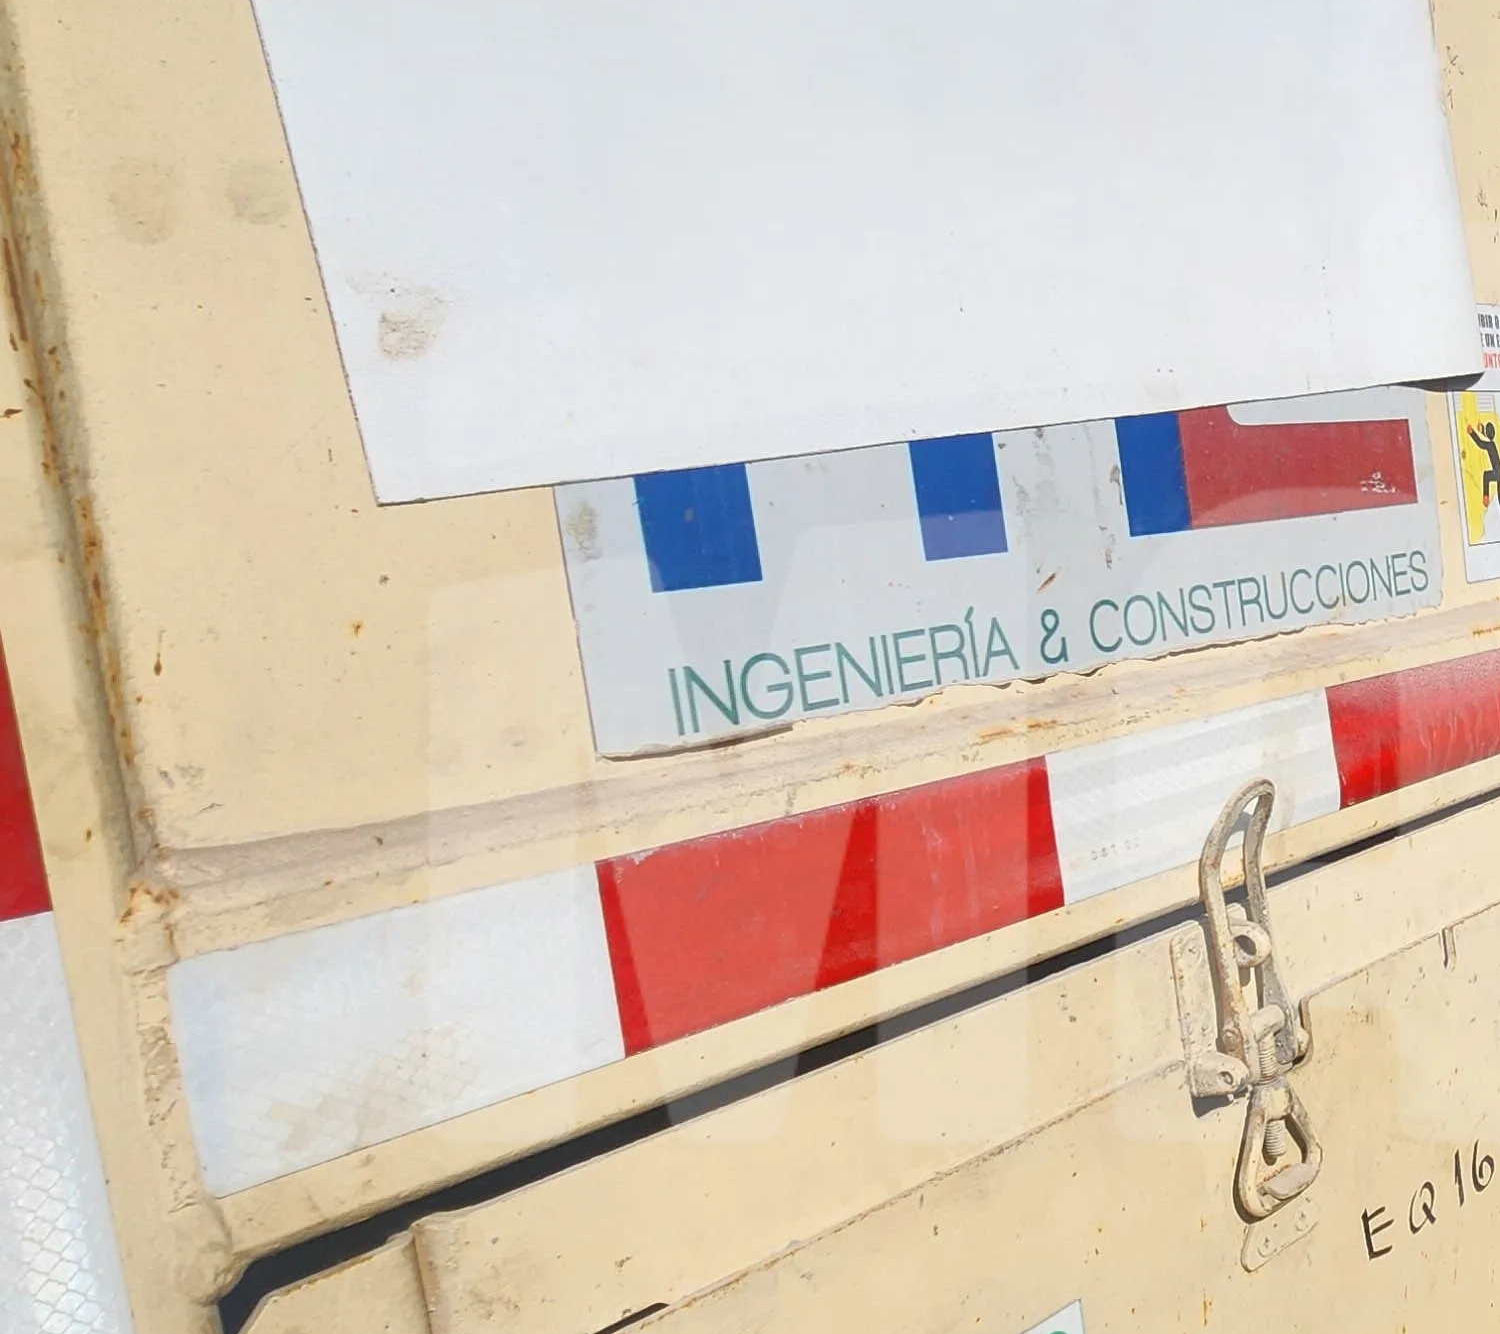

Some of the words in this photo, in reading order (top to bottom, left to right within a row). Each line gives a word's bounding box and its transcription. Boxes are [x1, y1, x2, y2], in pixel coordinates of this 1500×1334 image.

[667, 605, 1021, 737] INGENIERÍA
[1039, 608, 1069, 665] &
[1088, 549, 1430, 653] CONSTRUCCIONES
